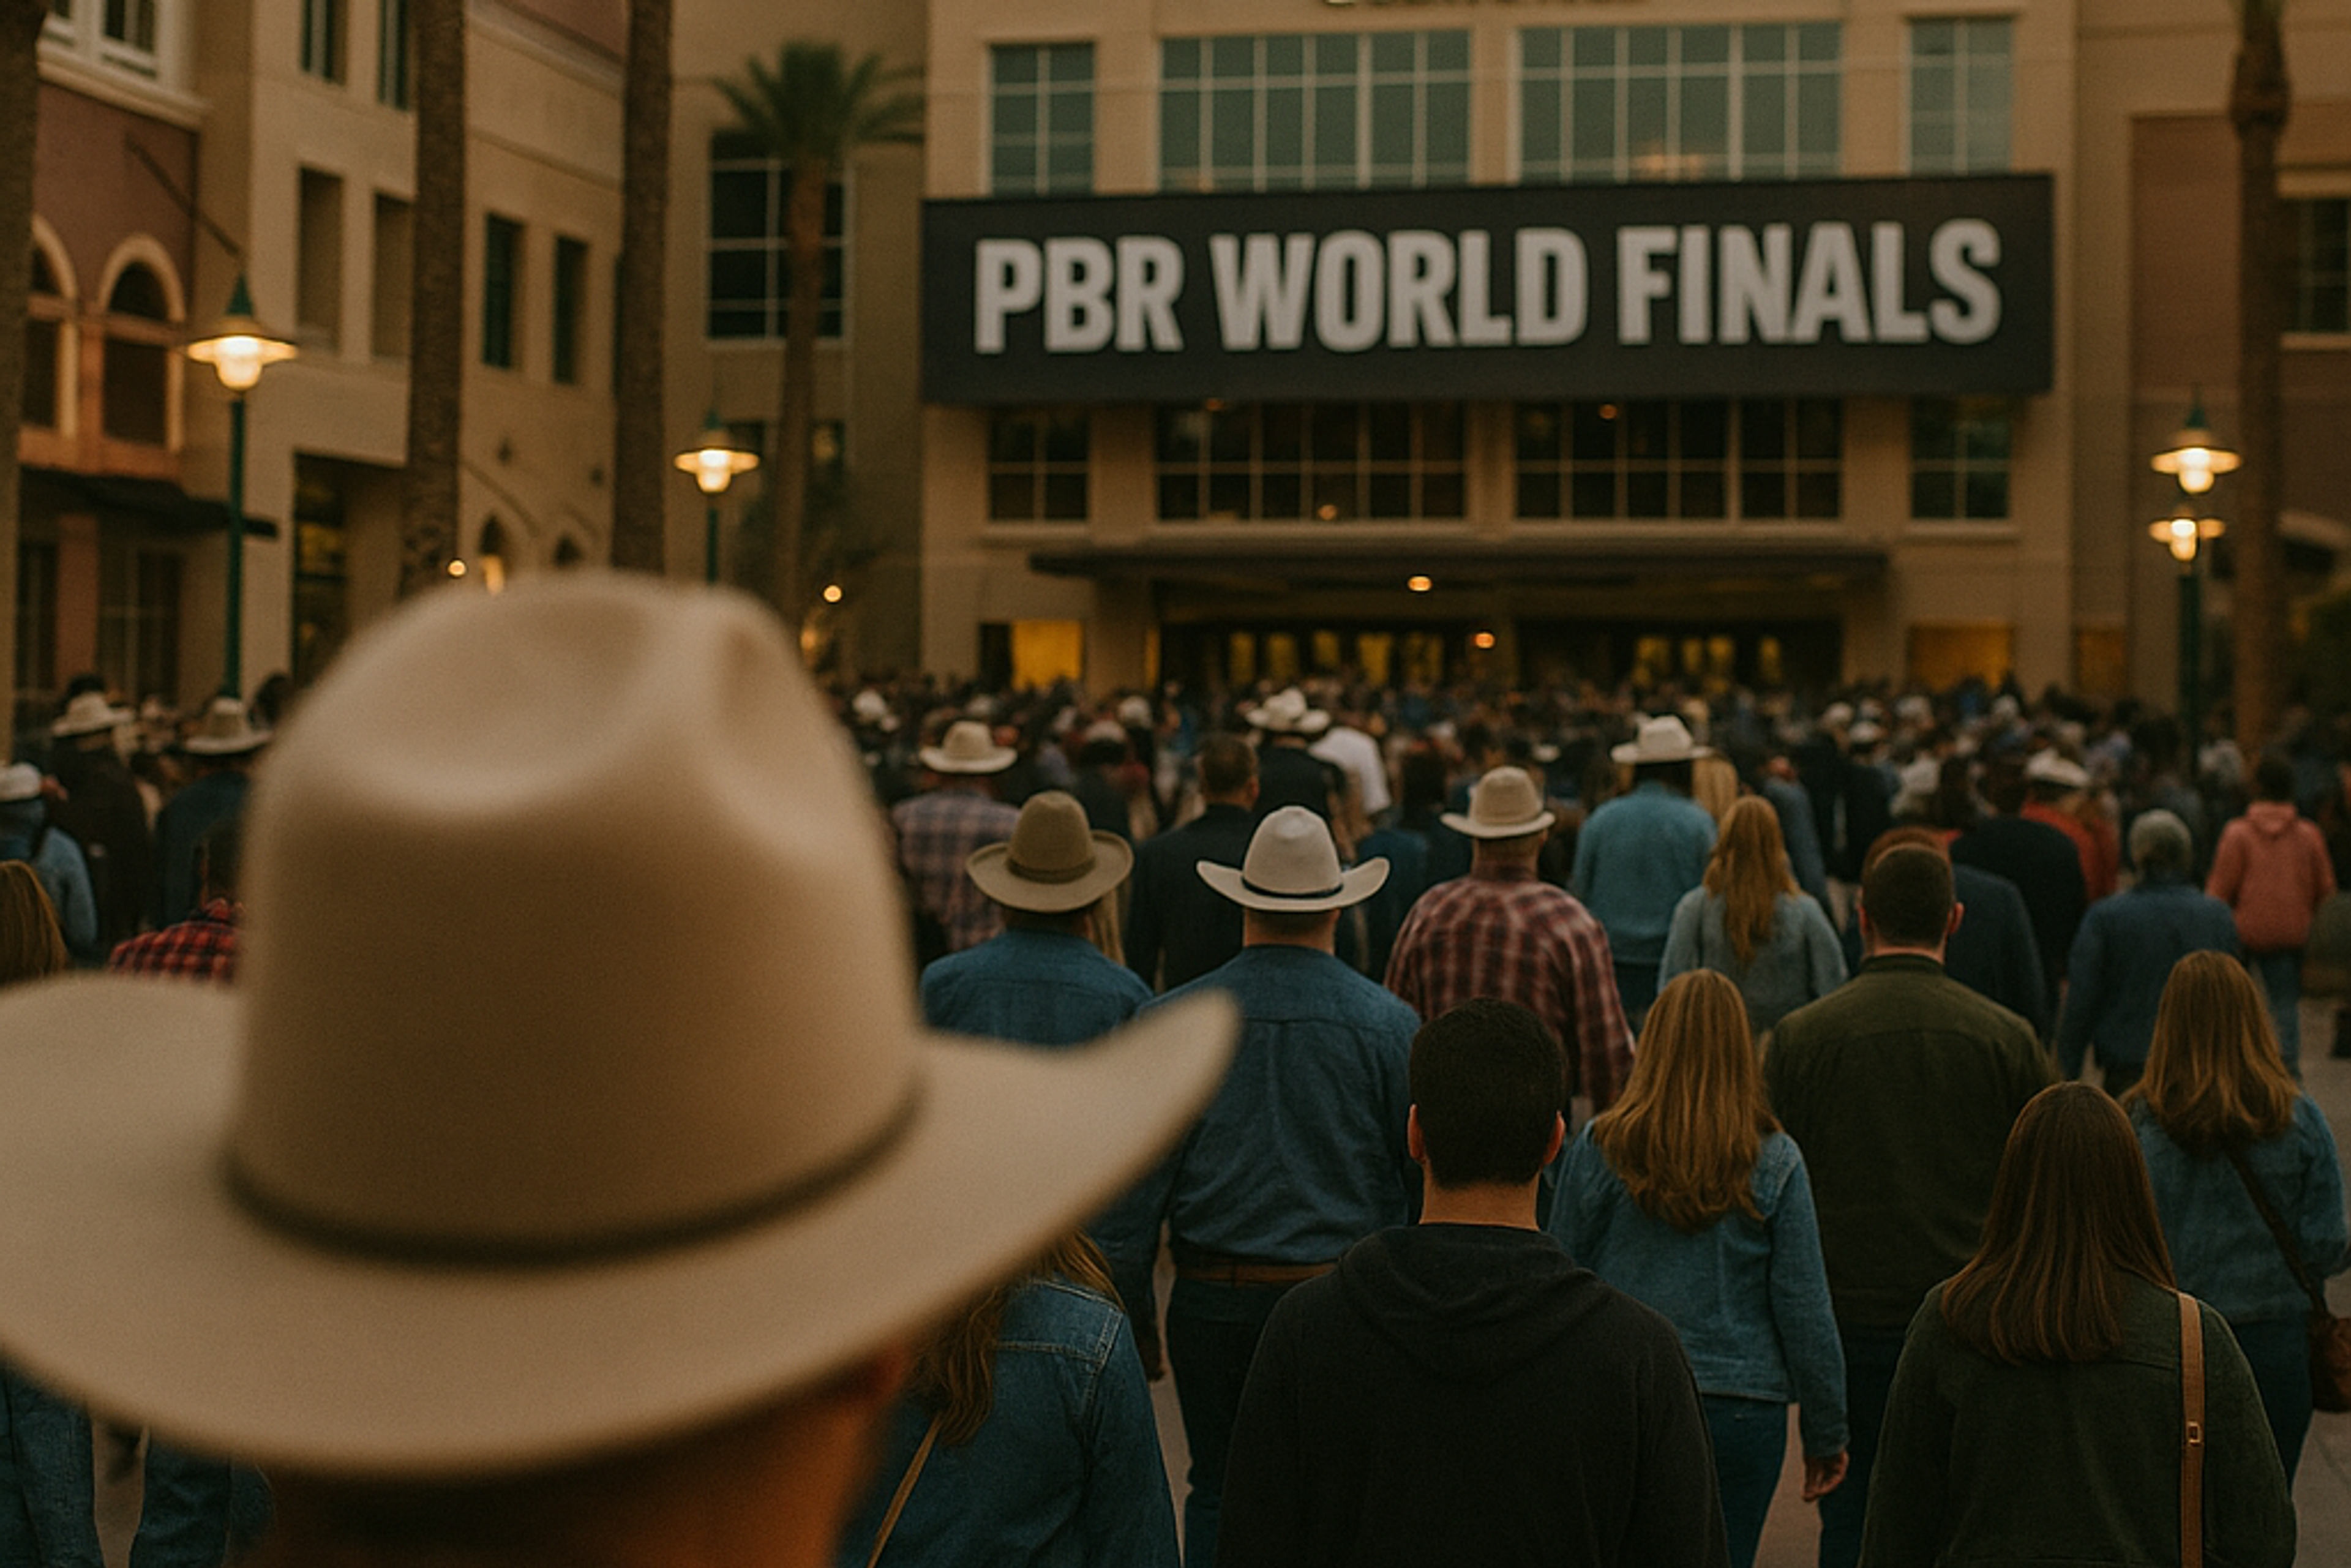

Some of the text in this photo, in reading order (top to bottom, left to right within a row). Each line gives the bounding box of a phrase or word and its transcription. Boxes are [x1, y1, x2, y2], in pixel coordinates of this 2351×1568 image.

[975, 219, 2002, 353] PBR WORLD FINALS
